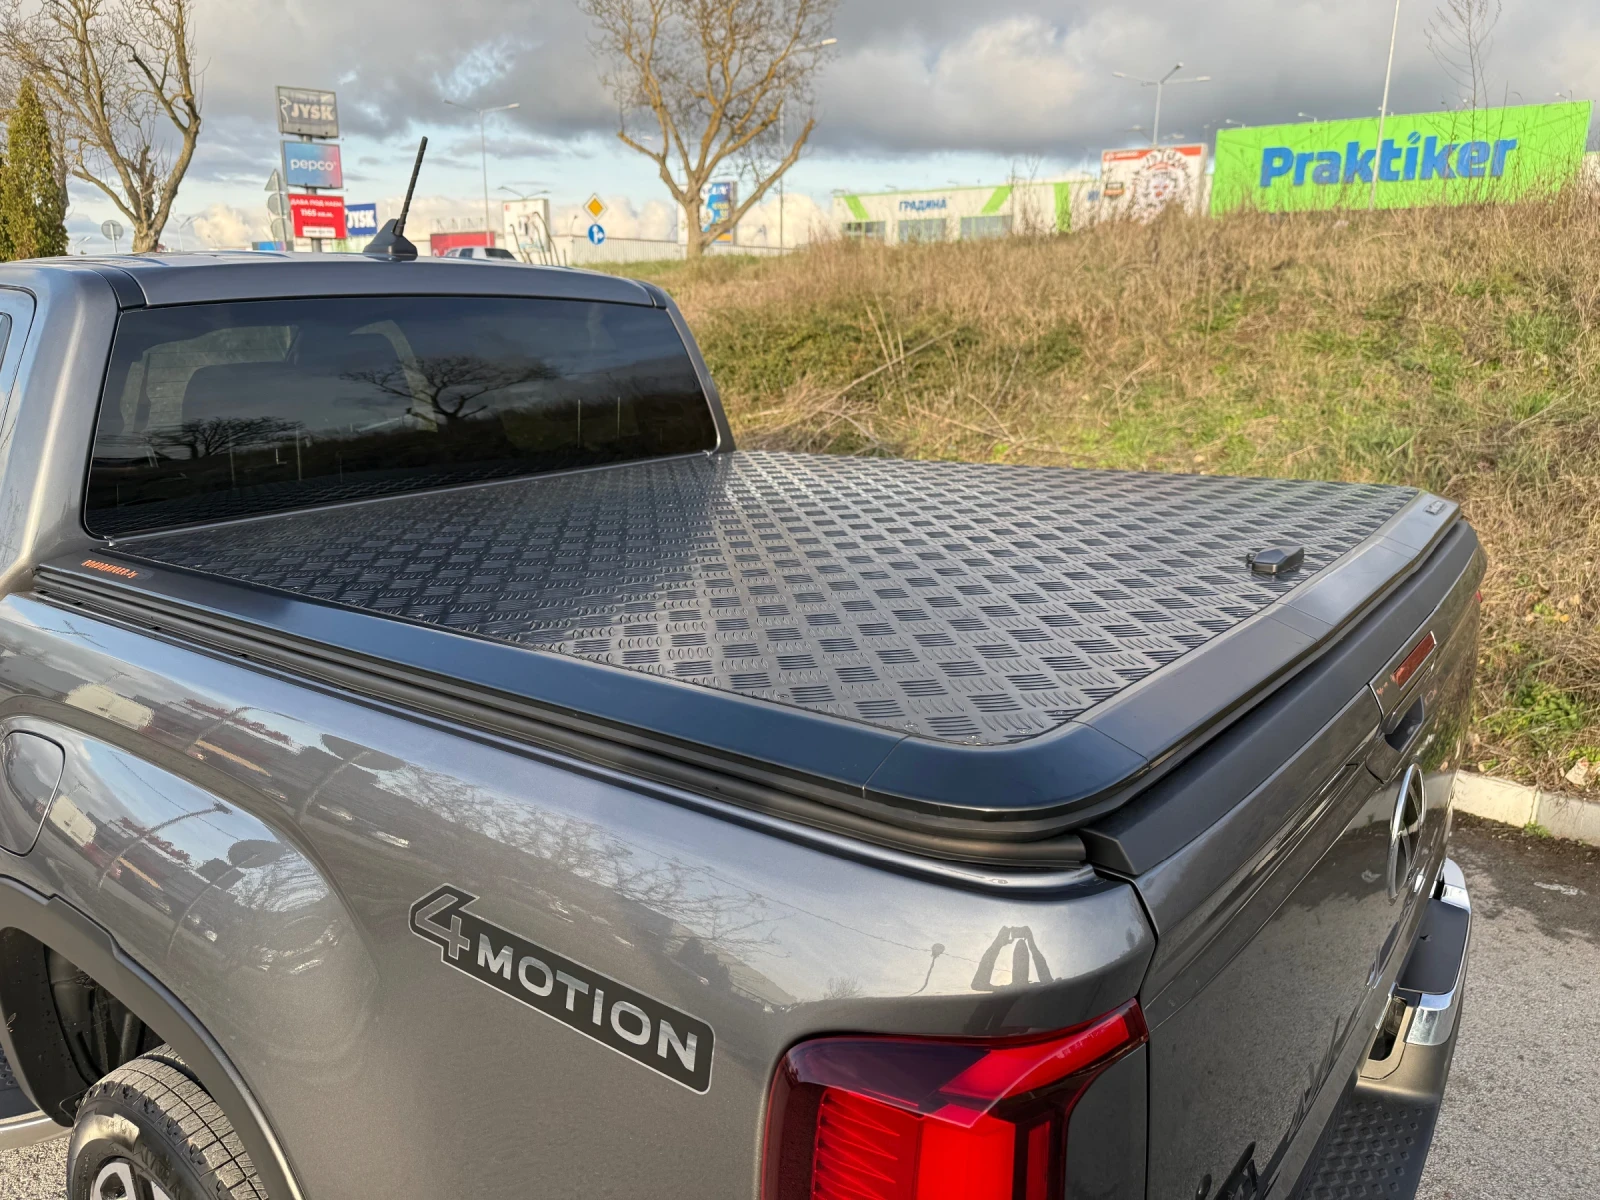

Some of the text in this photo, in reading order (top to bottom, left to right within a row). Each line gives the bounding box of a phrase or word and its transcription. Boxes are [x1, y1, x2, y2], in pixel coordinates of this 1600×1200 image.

[291, 103, 335, 121] JYSK
[290, 157, 335, 172] pepco
[1259, 131, 1517, 188] Praktiker
[899, 198, 947, 212] ГРАДИНА
[347, 209, 377, 229] JYSK
[414, 892, 698, 1073] 4MOTION
